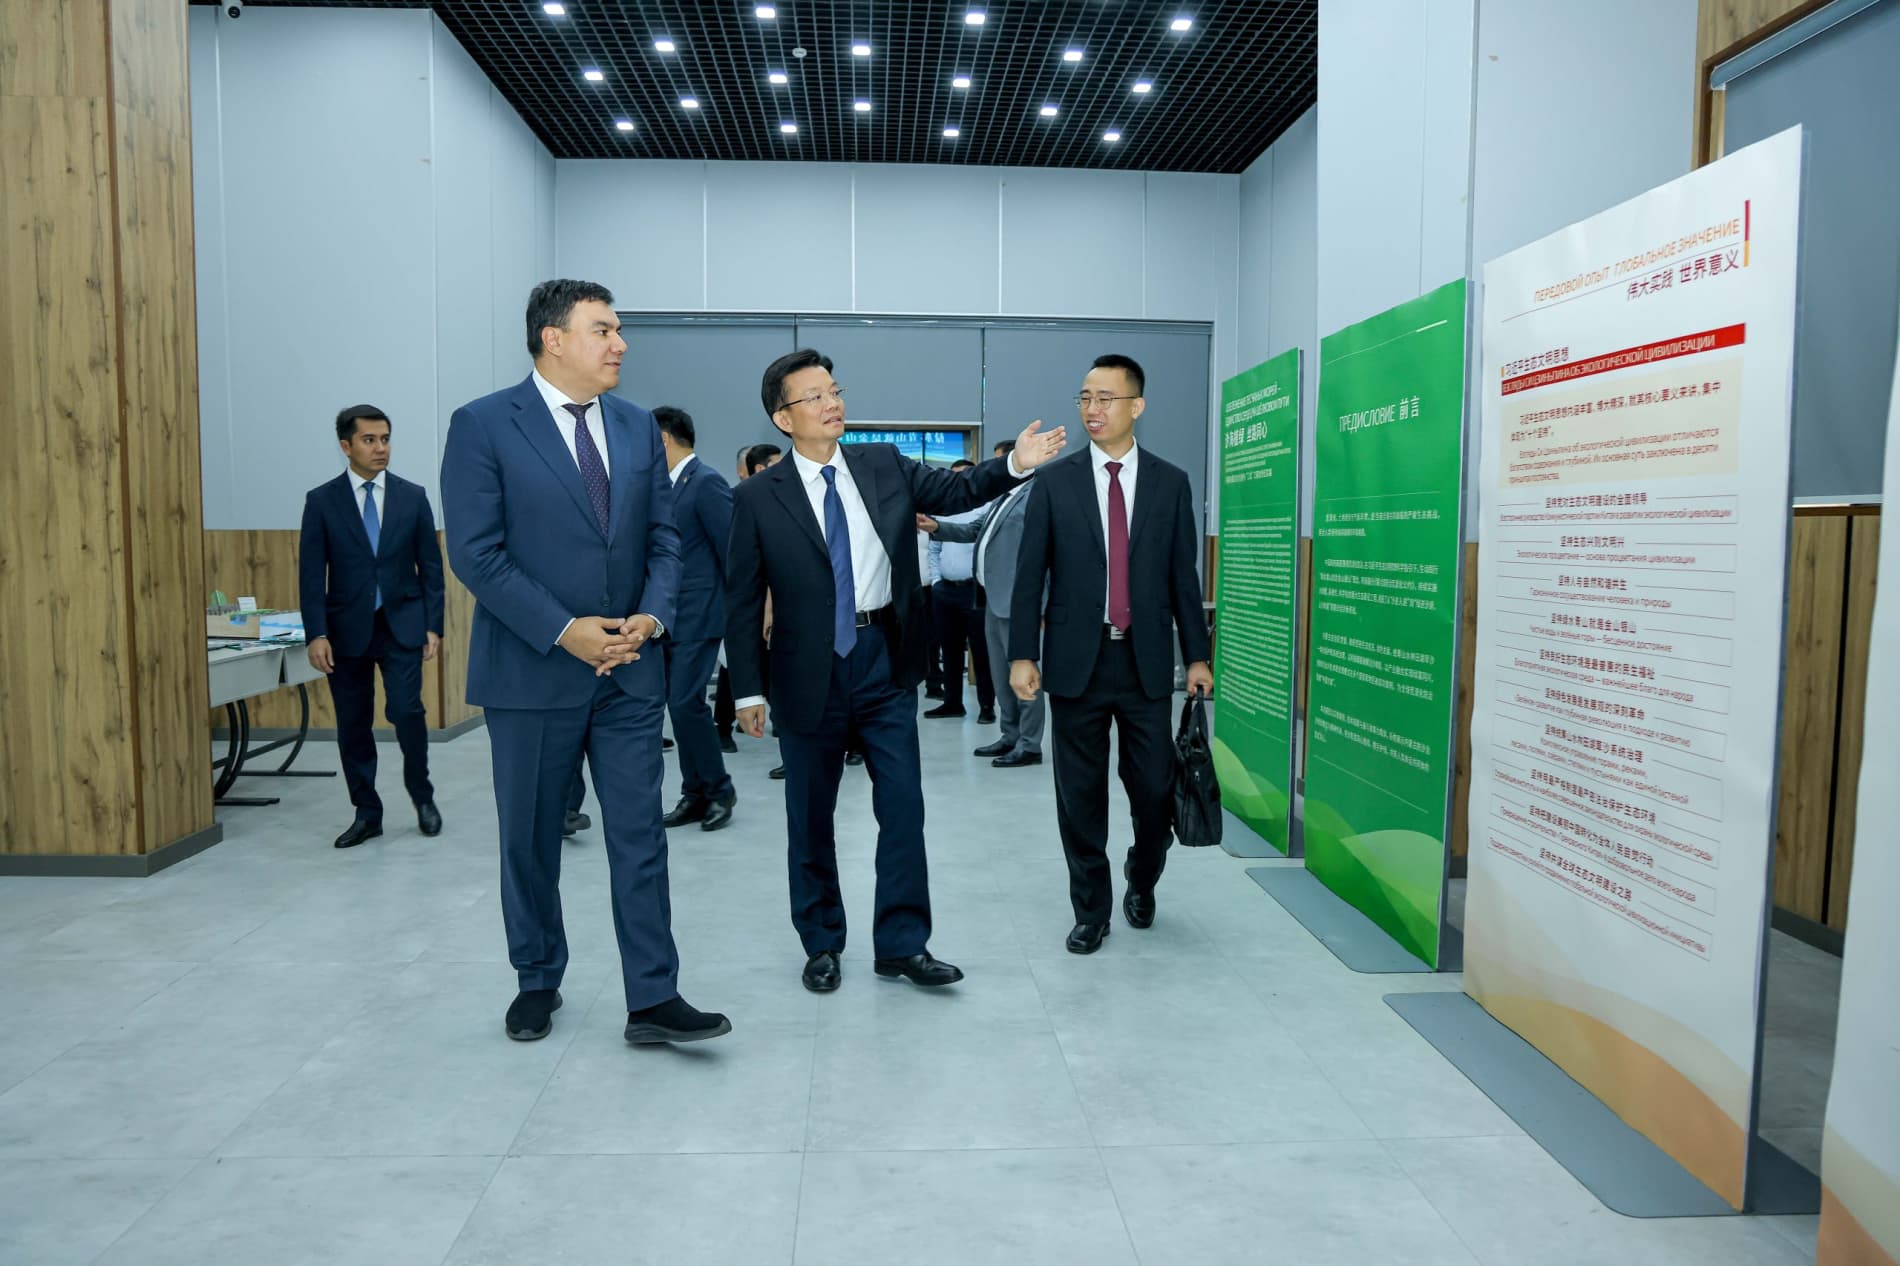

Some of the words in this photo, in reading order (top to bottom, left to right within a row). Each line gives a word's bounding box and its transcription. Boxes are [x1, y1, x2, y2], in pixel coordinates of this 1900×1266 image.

[1535, 274, 1583, 301] ПЕРЕДОВОЙ
[1584, 266, 1609, 286] ОПЫТ
[1615, 241, 1675, 272] ГЛОБАЛЬНОЕ
[1678, 219, 1740, 252] ЗНАЧЕНИЕ
[1627, 269, 1673, 301] 伟大实践
[1680, 249, 1739, 284] 世界意义
[1644, 335, 1715, 360] ЦИВИЛИЗАЦИИ
[1339, 404, 1395, 434] ПРЕДИСЛОВИЕ
[1399, 396, 1420, 421] 前言
